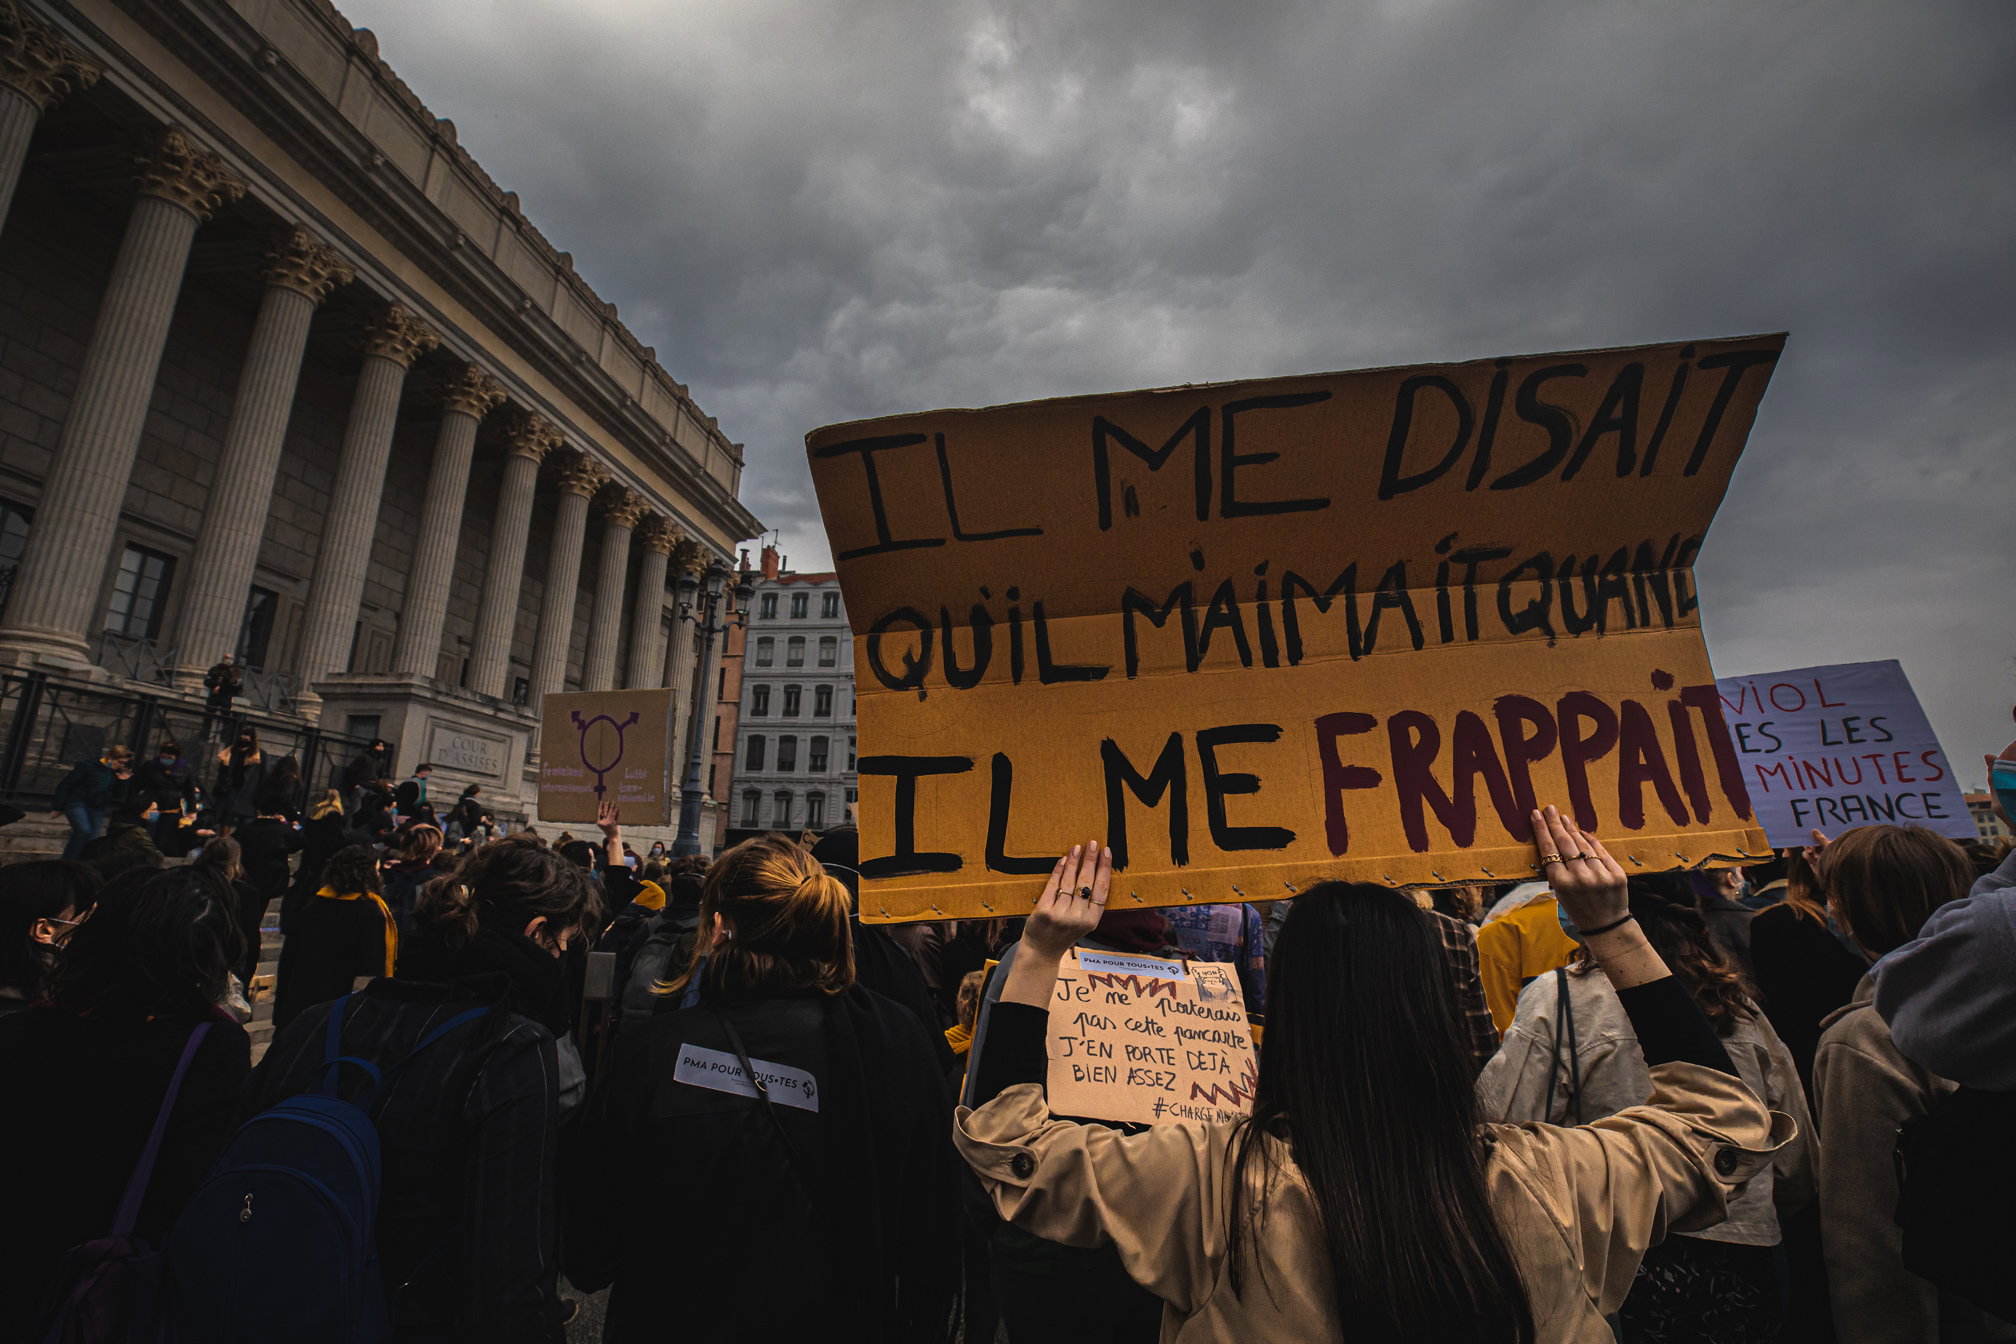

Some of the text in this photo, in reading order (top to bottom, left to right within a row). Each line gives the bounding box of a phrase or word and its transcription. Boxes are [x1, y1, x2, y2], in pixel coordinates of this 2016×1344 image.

[814, 432, 1044, 561] IL
[1092, 390, 1333, 531] ME
[452, 736, 487, 755] COUR
[1820, 716, 1893, 747] LES
[857, 752, 1067, 879] IL
[1101, 723, 1297, 873] ME
[1790, 792, 1951, 828] FRANCE
[1083, 957, 1101, 965] PMA
[1102, 959, 1125, 968] POUR
[1057, 978, 1092, 1002] Je
[1155, 997, 1242, 1022] porterais
[1073, 1012, 1249, 1050] pas cette pancarte
[683, 1056, 707, 1070] PMA
[710, 1062, 742, 1077] POUR
[1059, 1036, 1113, 1059] J'EN
[1124, 1044, 1177, 1066] PORTE
[1072, 1063, 1177, 1092] BIEN ASSEZ
